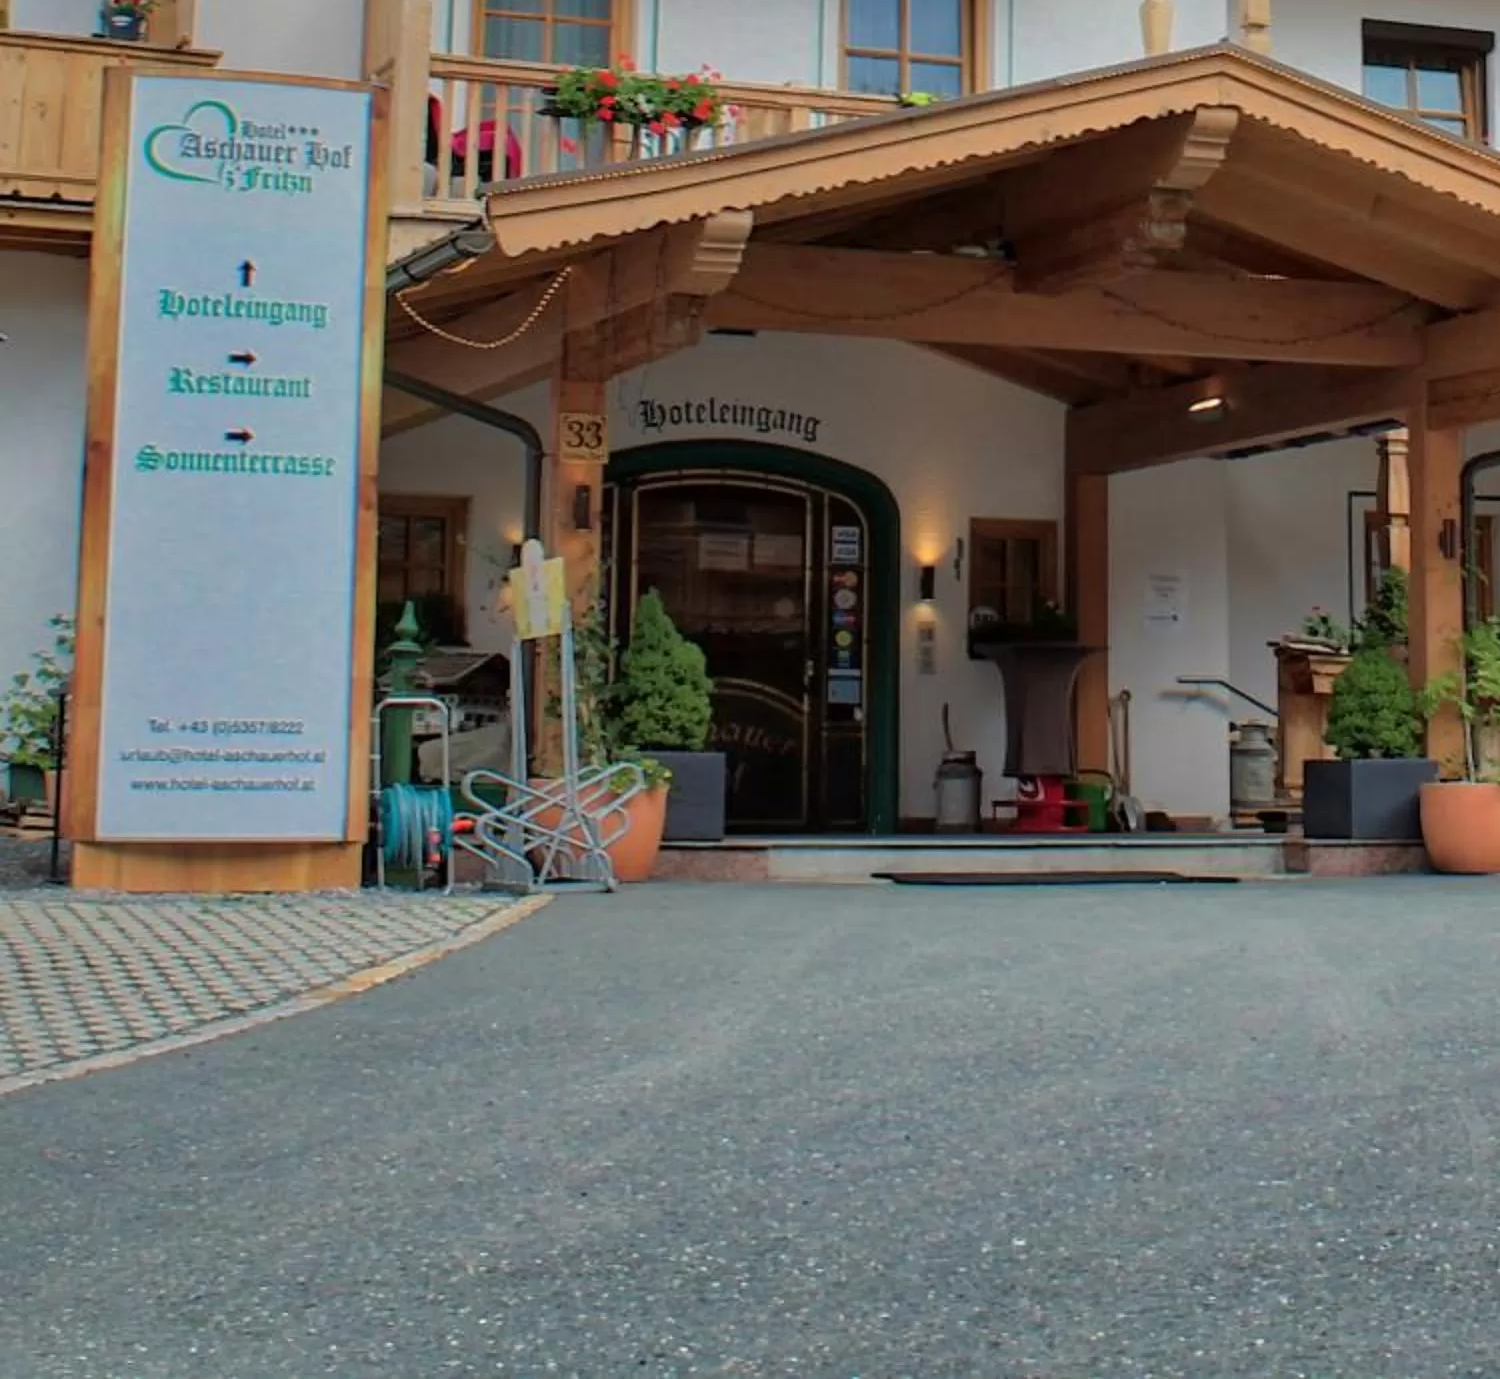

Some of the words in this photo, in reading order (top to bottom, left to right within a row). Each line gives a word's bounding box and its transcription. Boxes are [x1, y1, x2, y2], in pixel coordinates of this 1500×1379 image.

[240, 121, 286, 140] Hotel
[180, 133, 298, 165] Aschauer
[305, 140, 353, 169] Hof
[158, 289, 329, 329] Hoteleingang
[168, 366, 311, 399] Restaurant
[565, 420, 603, 450] 33
[639, 397, 821, 442] Hoteleingang
[135, 444, 337, 477] Sonnenterrasse
